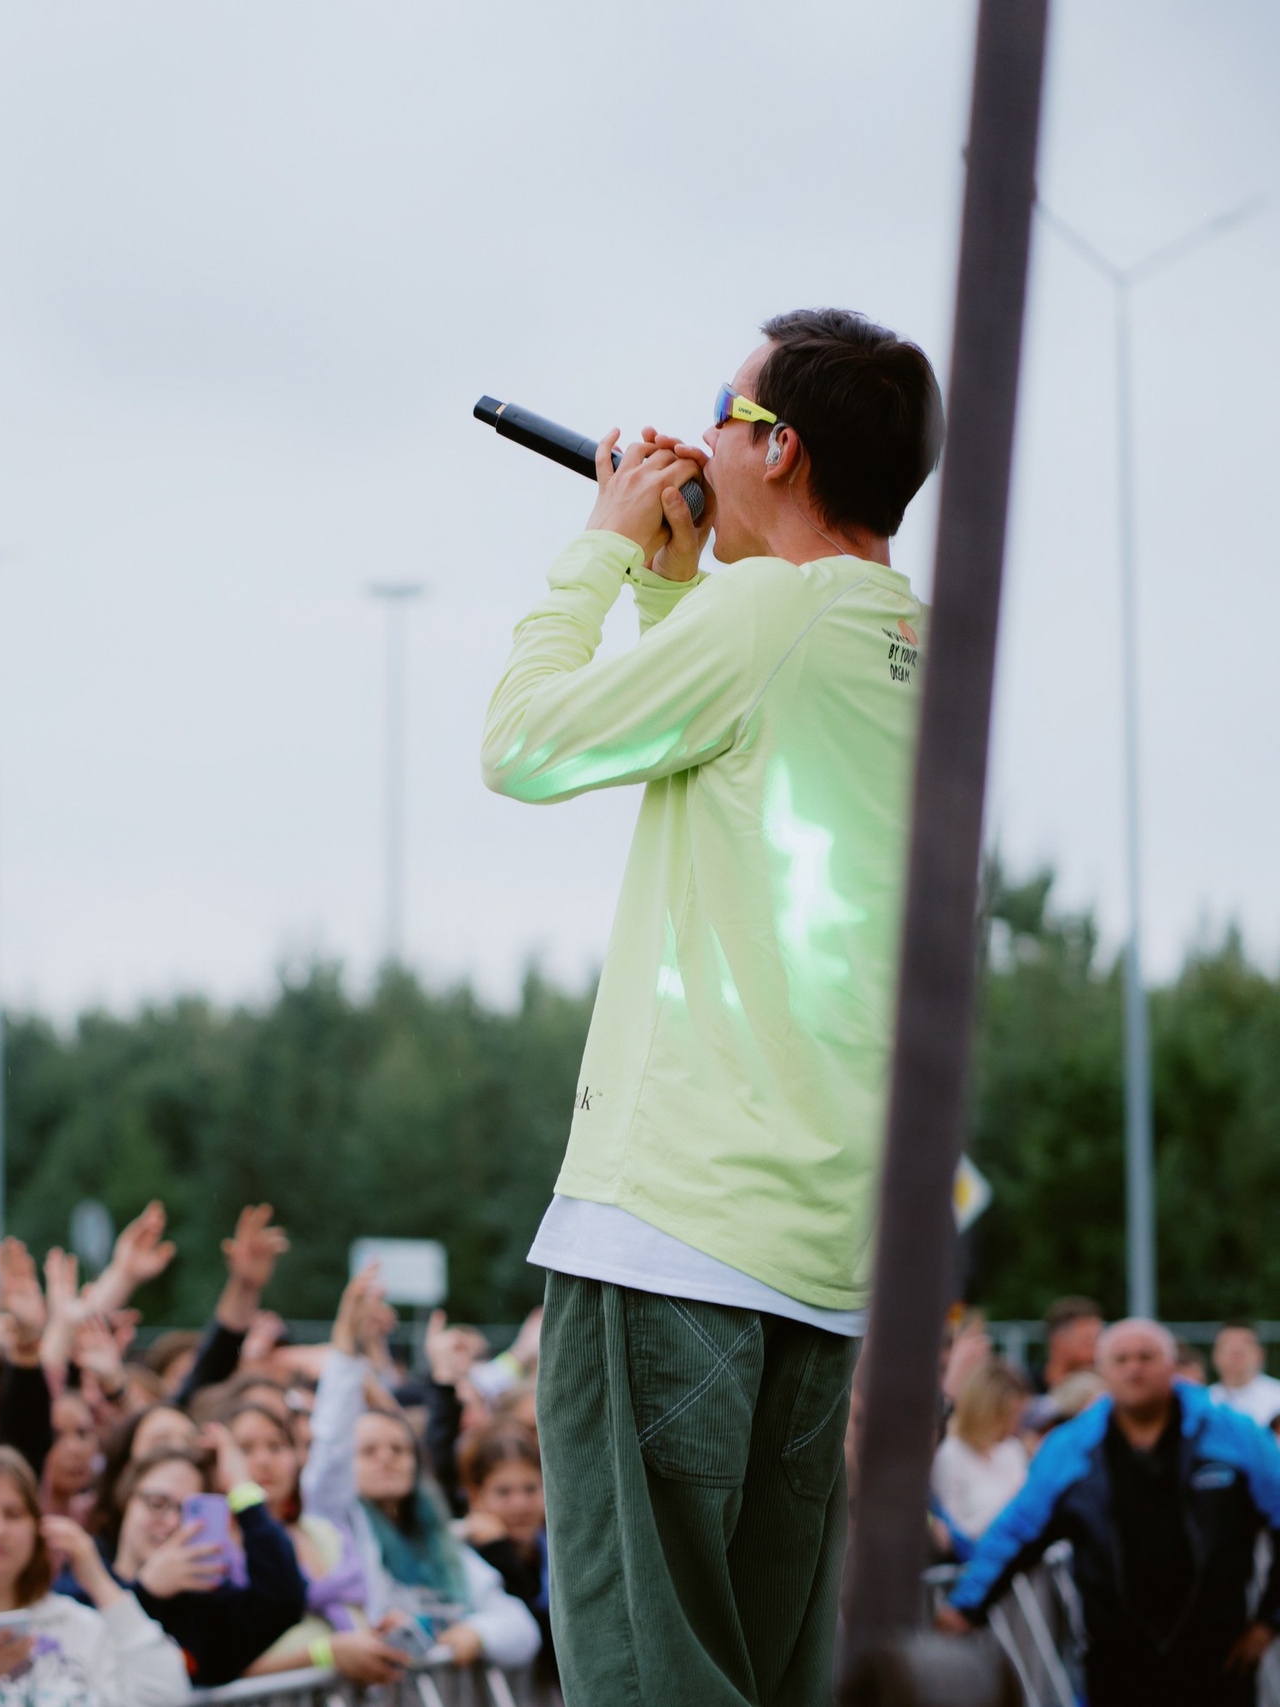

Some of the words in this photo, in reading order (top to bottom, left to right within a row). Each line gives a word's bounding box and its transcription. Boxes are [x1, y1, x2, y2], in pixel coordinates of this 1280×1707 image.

[888, 643, 900, 661] BY
[900, 646, 918, 668] YOUR
[889, 663, 911, 684] DREAM
